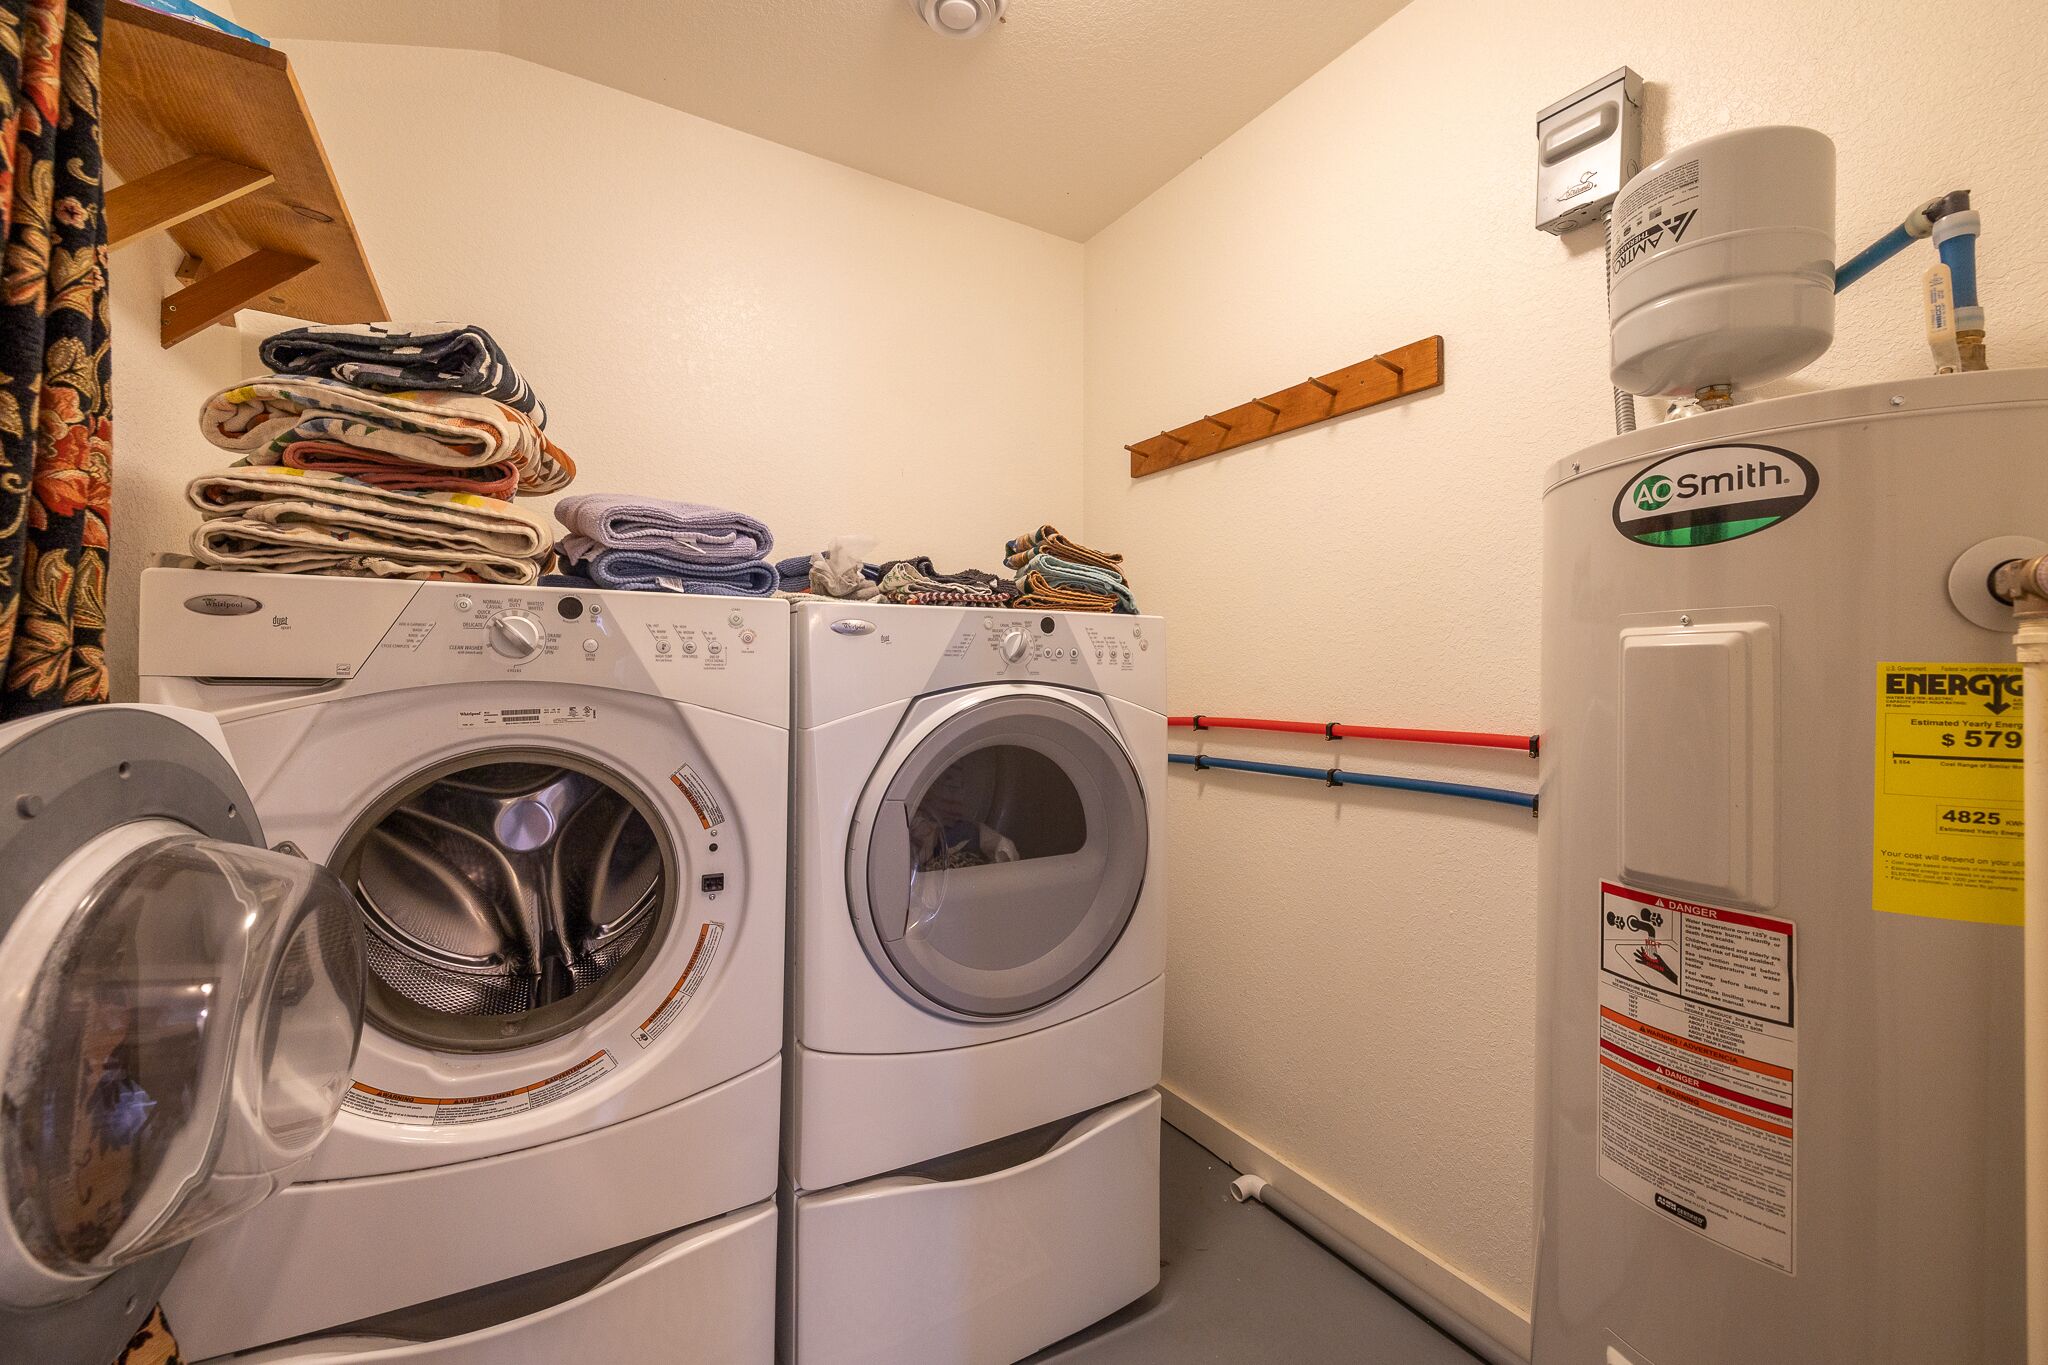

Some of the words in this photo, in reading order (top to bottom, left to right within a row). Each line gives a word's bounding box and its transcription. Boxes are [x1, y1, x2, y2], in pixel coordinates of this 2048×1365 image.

[1676, 461, 1782, 499] Smith
[1911, 719, 1959, 727] Estimated
[1962, 720, 1992, 729] Yearly
[1941, 733, 1955, 748] $
[1964, 730, 2022, 749] 579
[1942, 810, 2001, 825] 4825
[1904, 852, 1923, 860] cost
[1941, 855, 1975, 865] depend
[1668, 901, 1717, 919] DANGER
[1665, 1068, 1700, 1087] DANGER
